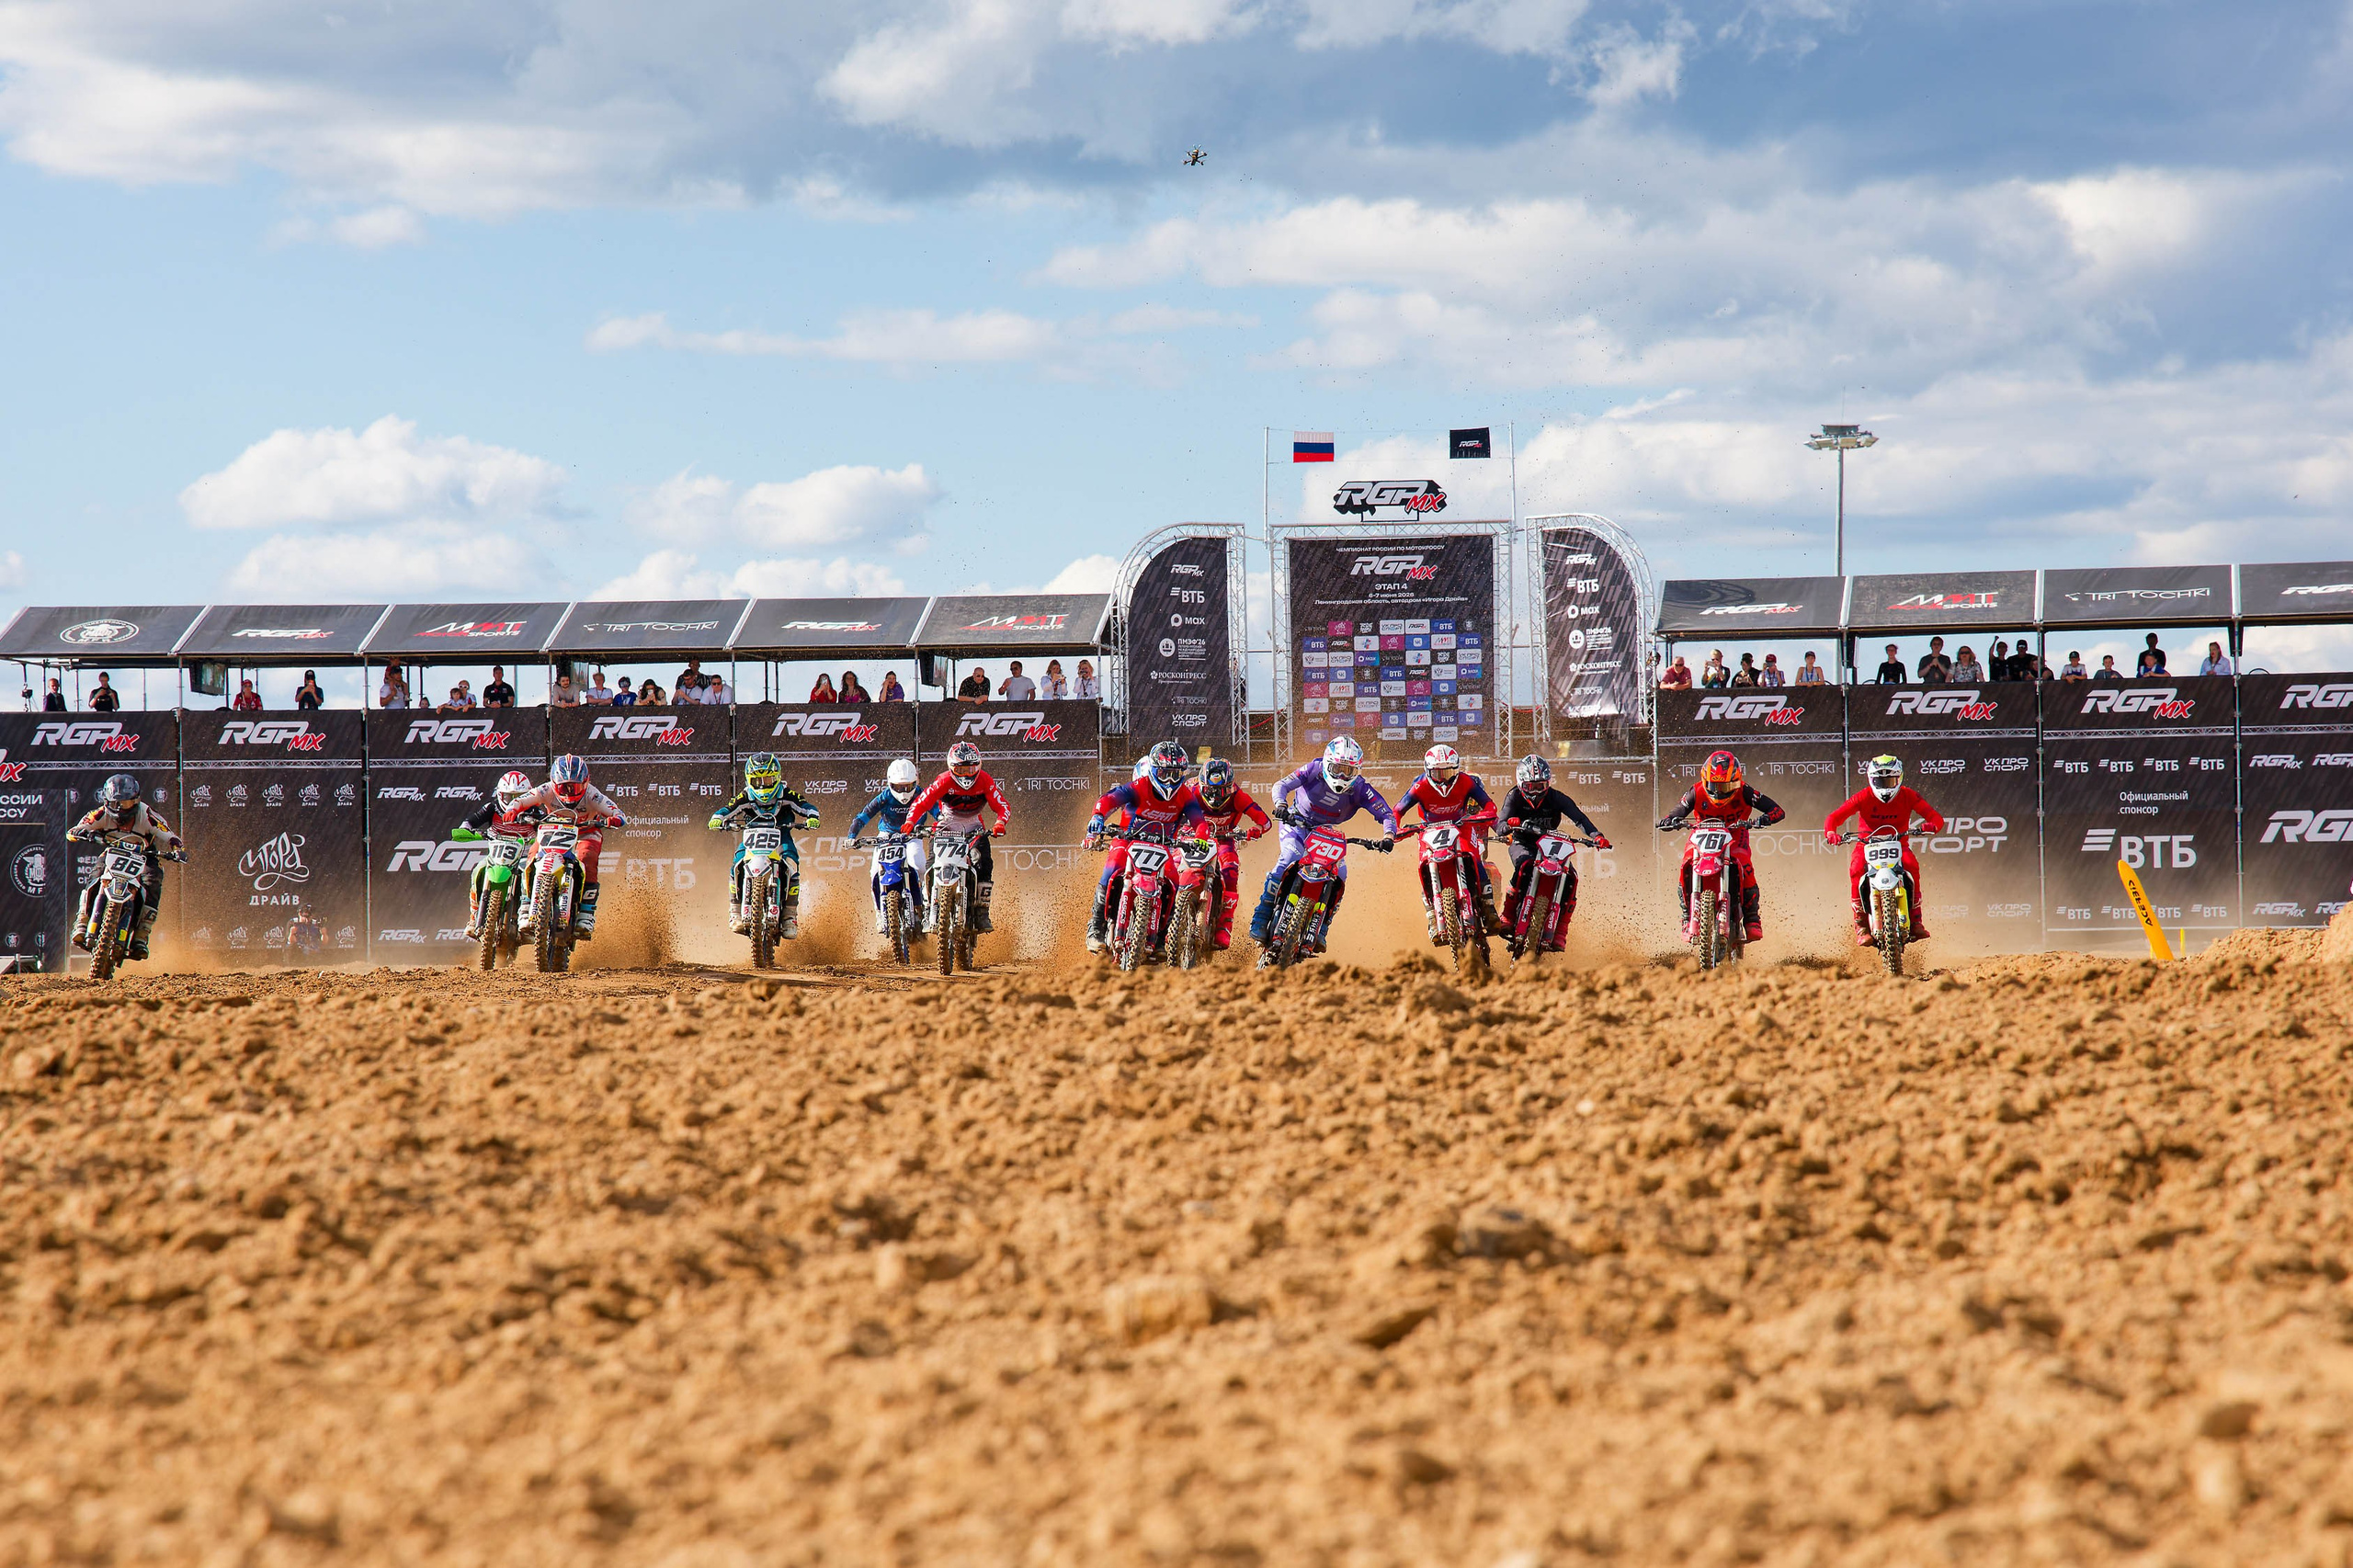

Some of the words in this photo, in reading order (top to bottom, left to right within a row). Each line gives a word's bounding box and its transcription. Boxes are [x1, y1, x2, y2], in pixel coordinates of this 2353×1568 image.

[1577, 579, 1599, 594] ВТБ
[1182, 590, 1205, 603] ВТБ
[1694, 695, 1788, 721] RGP
[1886, 690, 1980, 715] RGP
[2081, 688, 2177, 713] RGP
[588, 716, 678, 740] RGP
[772, 712, 861, 736] RGP
[955, 712, 1045, 735] RGP
[30, 722, 122, 745] RGP
[218, 721, 309, 744] RGP
[404, 719, 494, 744] RGP
[2065, 762, 2089, 773] ВТБ
[2109, 761, 2133, 773] ВТБ
[2155, 759, 2179, 771] ВТБ
[2200, 758, 2224, 770] ВТБ
[2249, 754, 2295, 767] RGP
[1578, 773, 1601, 784] ВТБ
[1622, 773, 1646, 784] ВТБ
[617, 786, 638, 797] ВТБ
[658, 785, 680, 796] ВТБ
[699, 784, 722, 796] ВТБ
[2120, 790, 2188, 802] Официальный
[2120, 805, 2158, 816] спонсор
[626, 815, 689, 828] Официальный
[2260, 810, 2353, 843] RG
[625, 829, 662, 839] спонсор
[745, 833, 779, 849] 425
[1432, 829, 1450, 846] 4
[1696, 833, 1726, 850] 761
[937, 843, 967, 858] 774
[1308, 838, 1344, 860] 730
[1549, 841, 1563, 856] 1
[1909, 835, 2007, 853] ПОРТ
[491, 844, 517, 860] 113
[879, 846, 904, 861] 454
[1131, 848, 1166, 867] 777
[1869, 847, 1899, 861] 999
[2120, 835, 2197, 869] ВТБ
[110, 857, 142, 876] 86
[626, 858, 696, 890] ВТБ
[249, 892, 300, 906] ДРАЙВ
[2068, 908, 2091, 920] ВТБ
[2113, 907, 2135, 919] ВТБ
[2158, 907, 2181, 918] ВТБ
[2203, 906, 2227, 918] ВТБ
